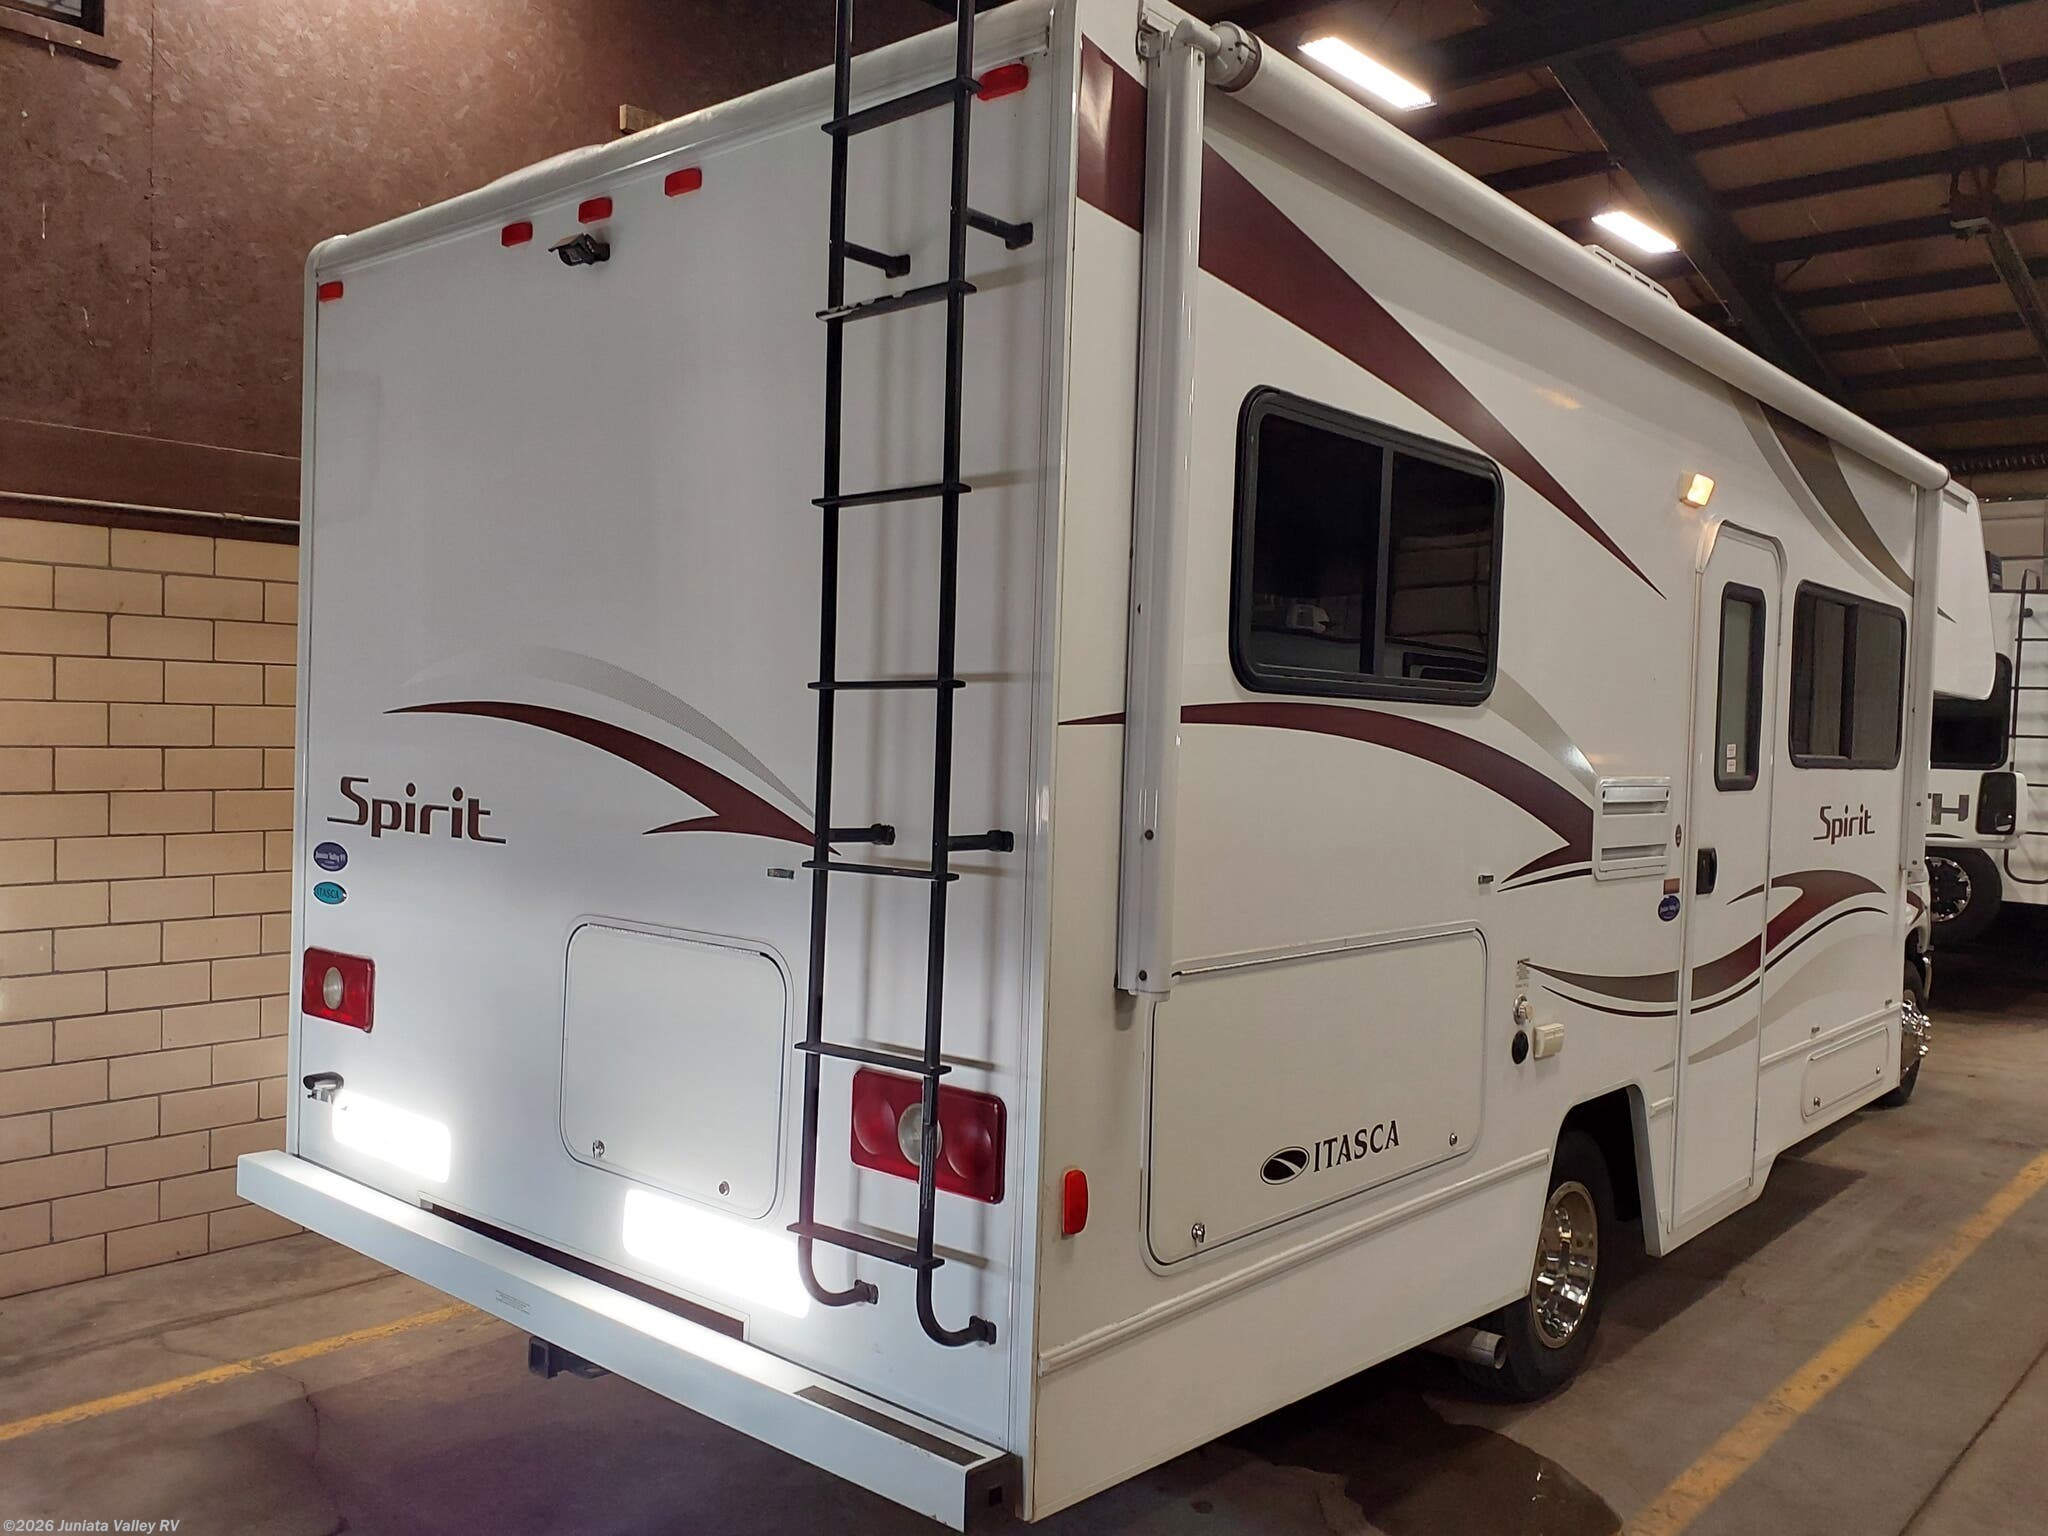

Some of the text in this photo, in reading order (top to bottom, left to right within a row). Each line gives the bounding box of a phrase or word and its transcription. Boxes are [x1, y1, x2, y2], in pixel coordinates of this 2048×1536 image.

[327, 776, 506, 844] Spirit
[1813, 804, 1875, 845] Spirit
[1313, 1120, 1400, 1172] ITASCA
